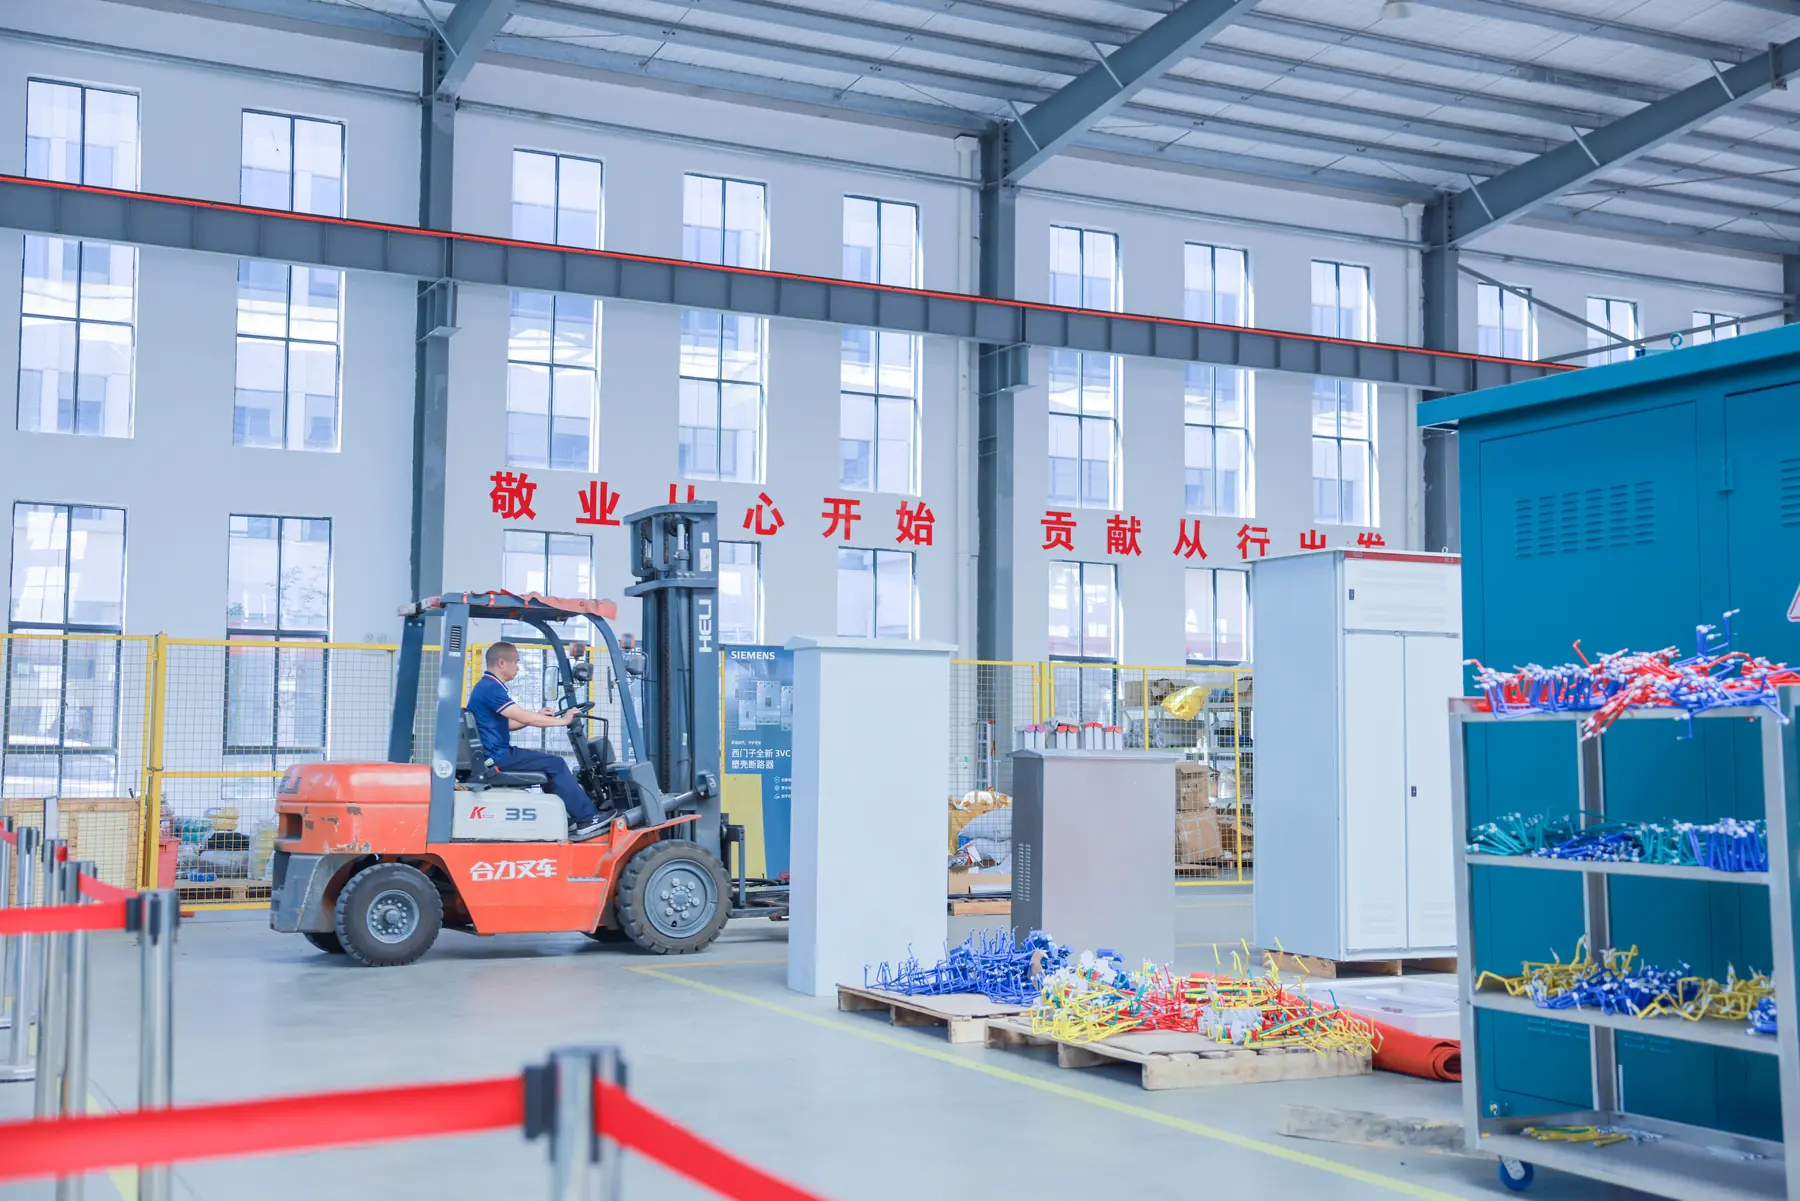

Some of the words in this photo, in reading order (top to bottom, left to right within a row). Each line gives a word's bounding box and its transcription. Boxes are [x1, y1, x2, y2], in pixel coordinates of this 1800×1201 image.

[698, 599, 712, 653] HELI
[731, 651, 776, 661] SIEMENS
[731, 748, 774, 758] 西门子全新
[505, 808, 537, 821] 35
[469, 858, 558, 881] 合力叉车
